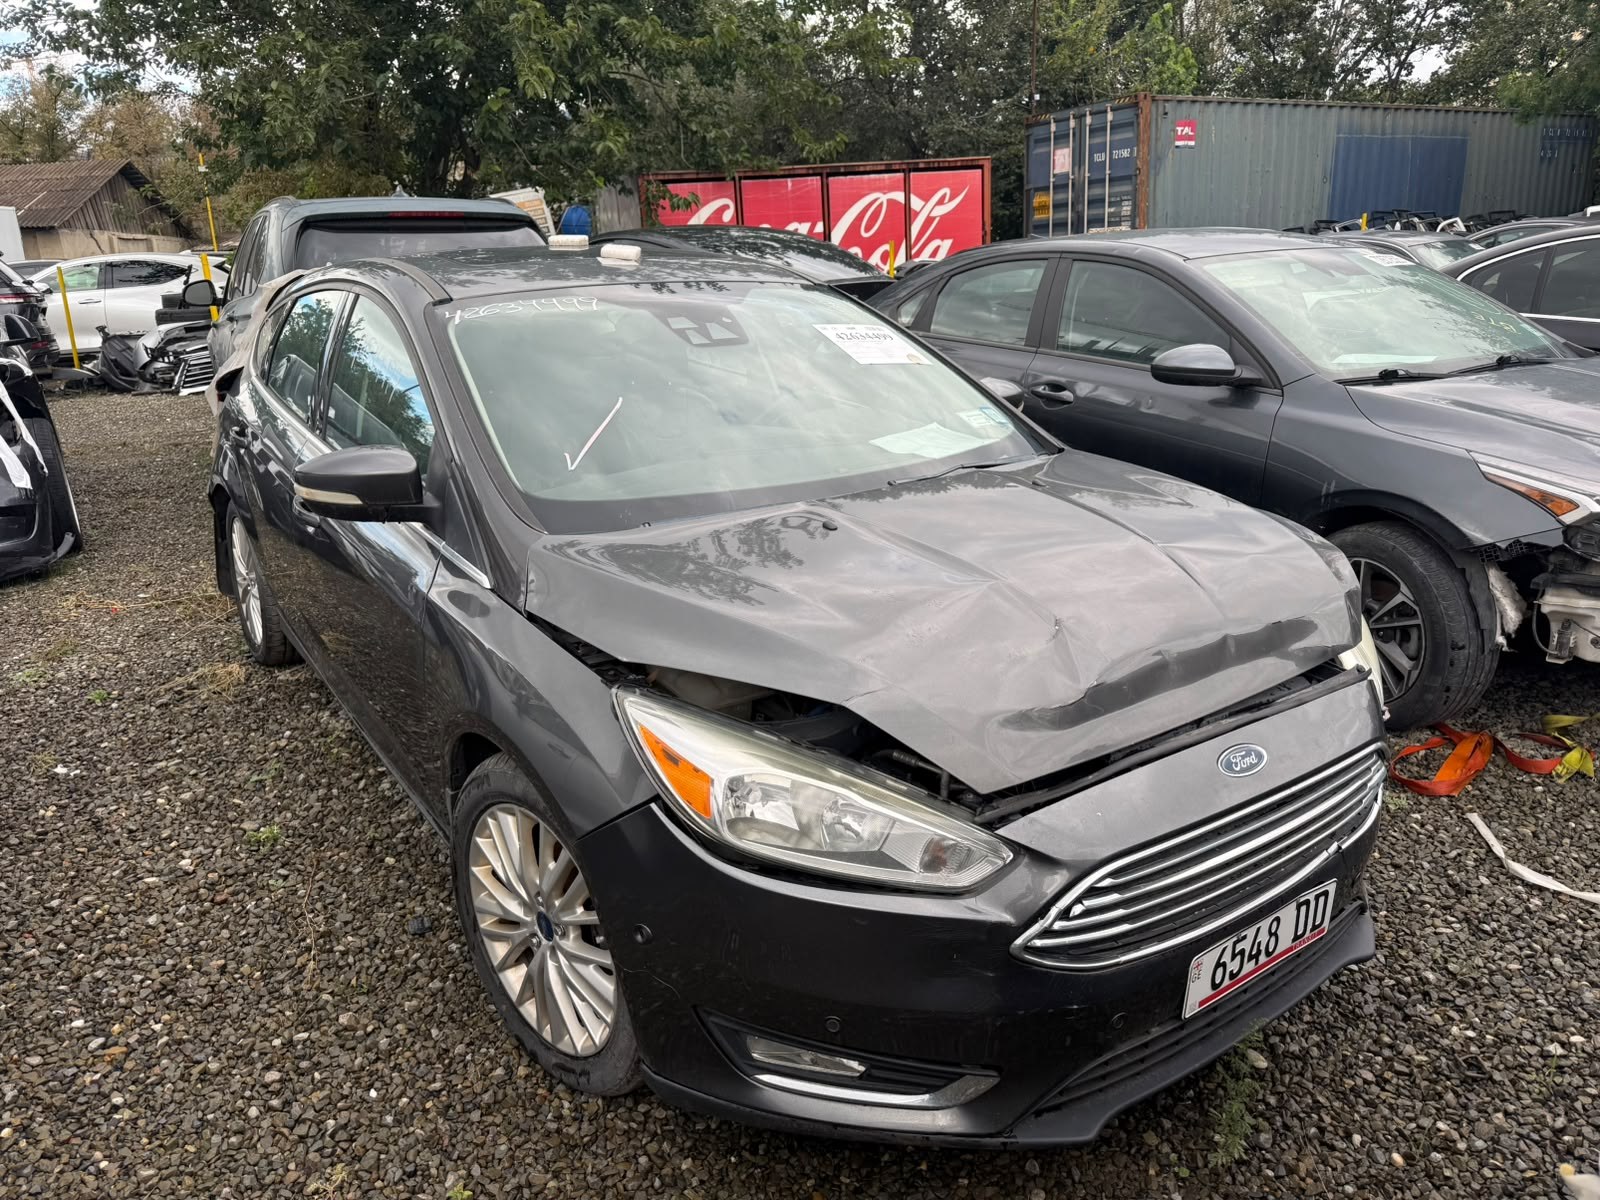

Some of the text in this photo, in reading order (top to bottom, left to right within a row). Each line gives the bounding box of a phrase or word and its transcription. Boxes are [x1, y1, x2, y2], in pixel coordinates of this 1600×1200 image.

[1176, 126, 1195, 136] TAL
[1094, 152, 1106, 162] TCLU
[1112, 148, 1131, 160] 721582
[445, 296, 599, 325] 42634499
[1230, 750, 1258, 771] Ford
[1210, 889, 1330, 991] 6548 DD
